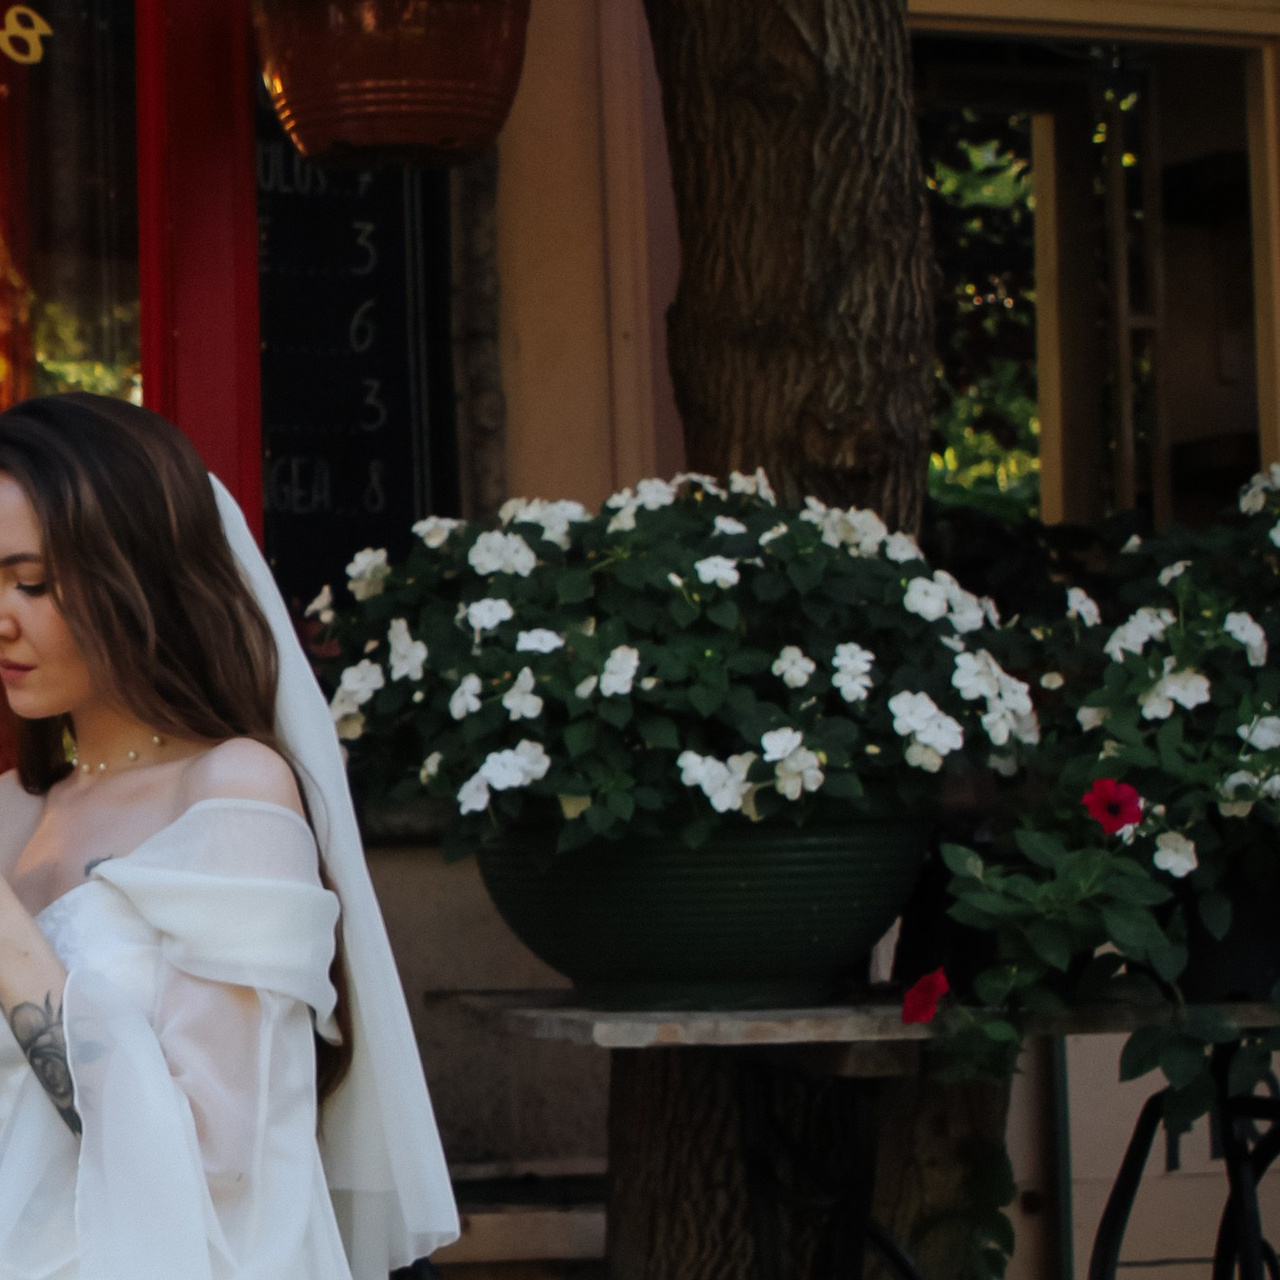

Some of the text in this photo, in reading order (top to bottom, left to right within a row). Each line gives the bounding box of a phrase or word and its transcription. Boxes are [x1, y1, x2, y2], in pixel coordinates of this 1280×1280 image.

[350, 220, 378, 276] 3
[349, 295, 378, 354] 6
[360, 377, 387, 432] 3
